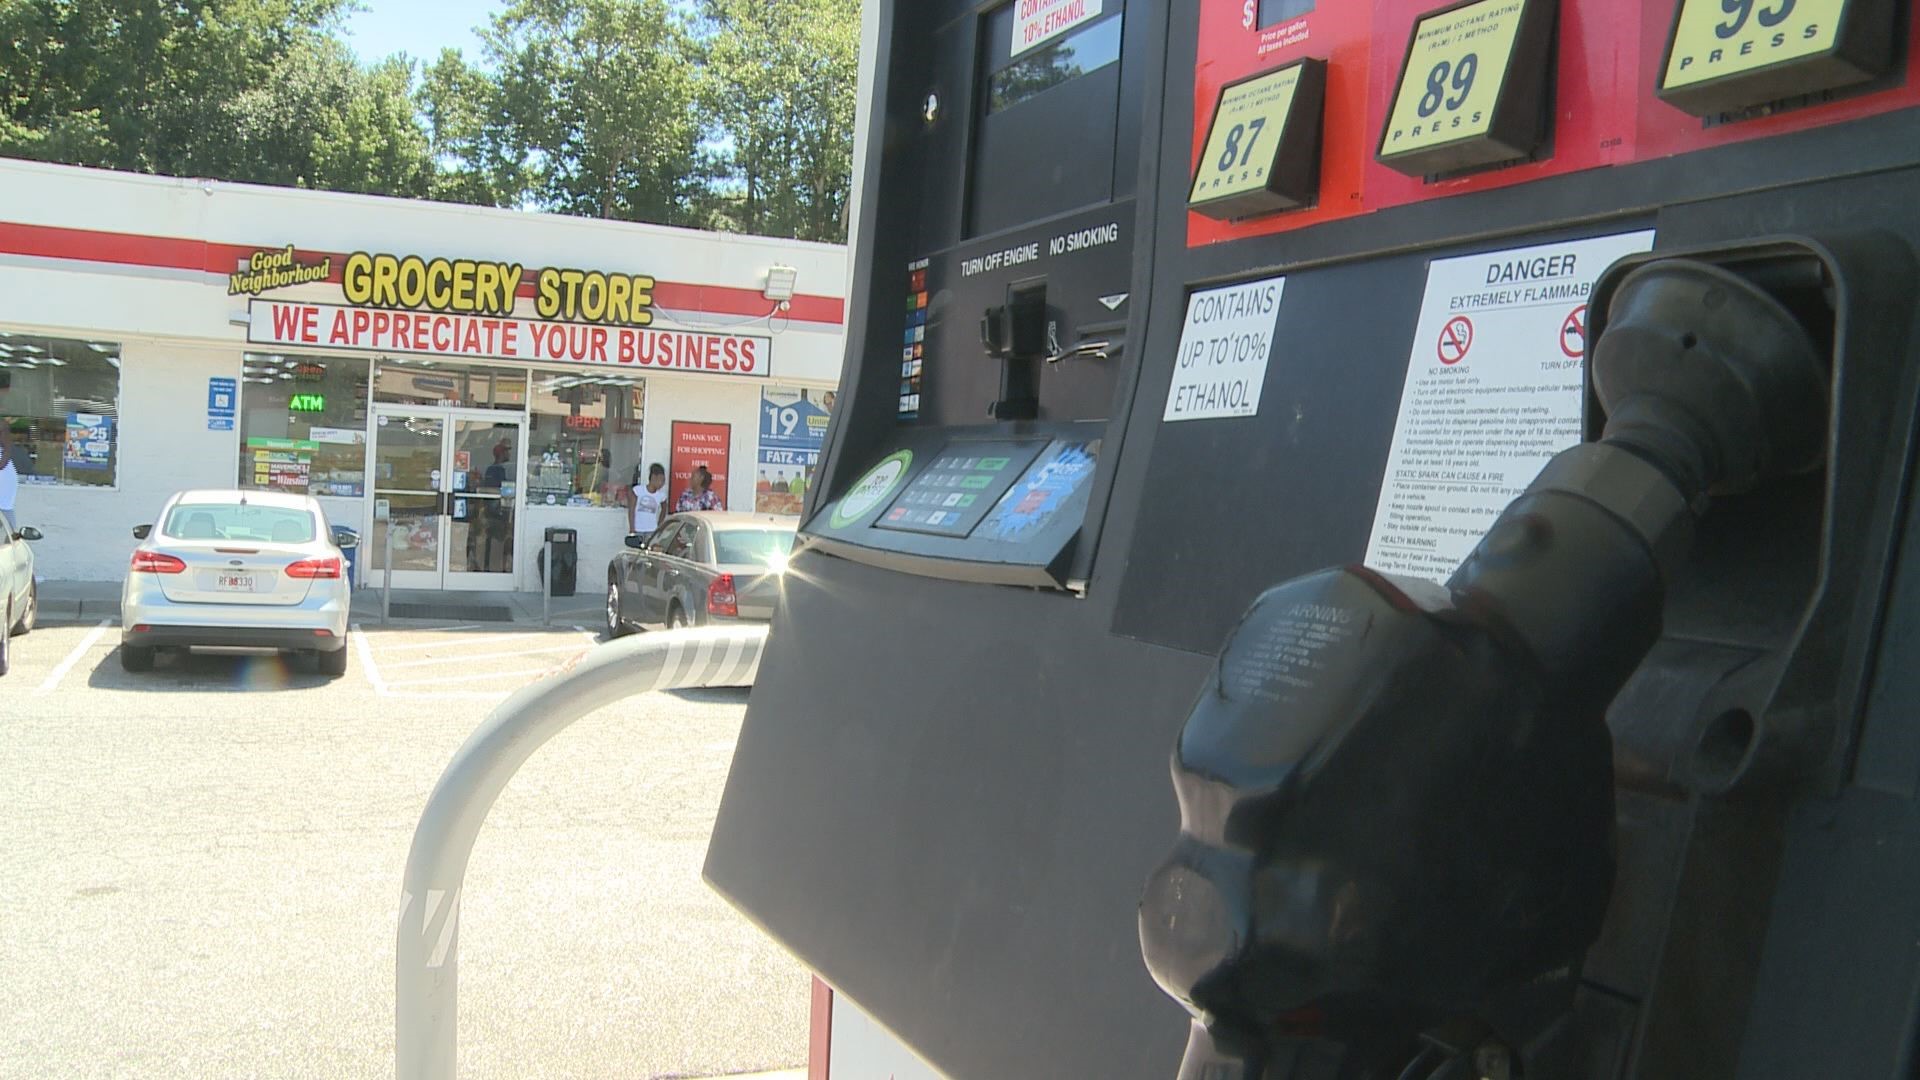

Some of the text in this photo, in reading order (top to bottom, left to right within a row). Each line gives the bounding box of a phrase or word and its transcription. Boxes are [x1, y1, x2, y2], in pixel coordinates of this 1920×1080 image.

[1023, 0, 1085, 44] 10% ETHANOL
[1261, 20, 1307, 43] Price per gallon
[1418, 3, 1520, 41] MINIMUM OCTANE RATING
[1464, 23, 1499, 40] METHOD
[1282, 31, 1309, 50] included
[1680, 23, 1818, 71] PRESS
[1272, 76, 1296, 92] RATING
[1417, 52, 1478, 118] 89
[1393, 111, 1481, 142] PRESS
[1217, 116, 1266, 172] 87
[1199, 166, 1263, 191] PRESS
[1049, 222, 1118, 257] NO SMOKING
[249, 246, 294, 273] Good
[961, 242, 1039, 278] TURN OFF ENGINE
[1486, 253, 1577, 285] DANGER
[229, 260, 330, 296] Neighborhood
[344, 252, 655, 326] GROCERY STORE
[1192, 285, 1276, 325] CONTAINS
[1449, 282, 1590, 310] EXTREMELY FLAMMAB
[272, 304, 757, 373] WE APPRECIATE YOUR BUSINESS
[1181, 331, 1267, 370] UP TO 10%
[1428, 365, 1470, 376] NO SMOKING
[1541, 361, 1561, 370] TURN
[1562, 360, 1578, 370] OFF
[290, 394, 324, 411] ATM
[1174, 378, 1251, 413] ETHANOL
[88, 426, 107, 441] 25
[566, 415, 602, 428] OPEN
[677, 445, 726, 456] FOR SHOPPING
[682, 432, 722, 444] THANK YOU
[766, 451, 793, 465] FATZ
[1396, 469, 1505, 483] STATIC SPARK CAN CAUSE A FIRE
[1380, 535, 1437, 549] HEALTH WARNING
